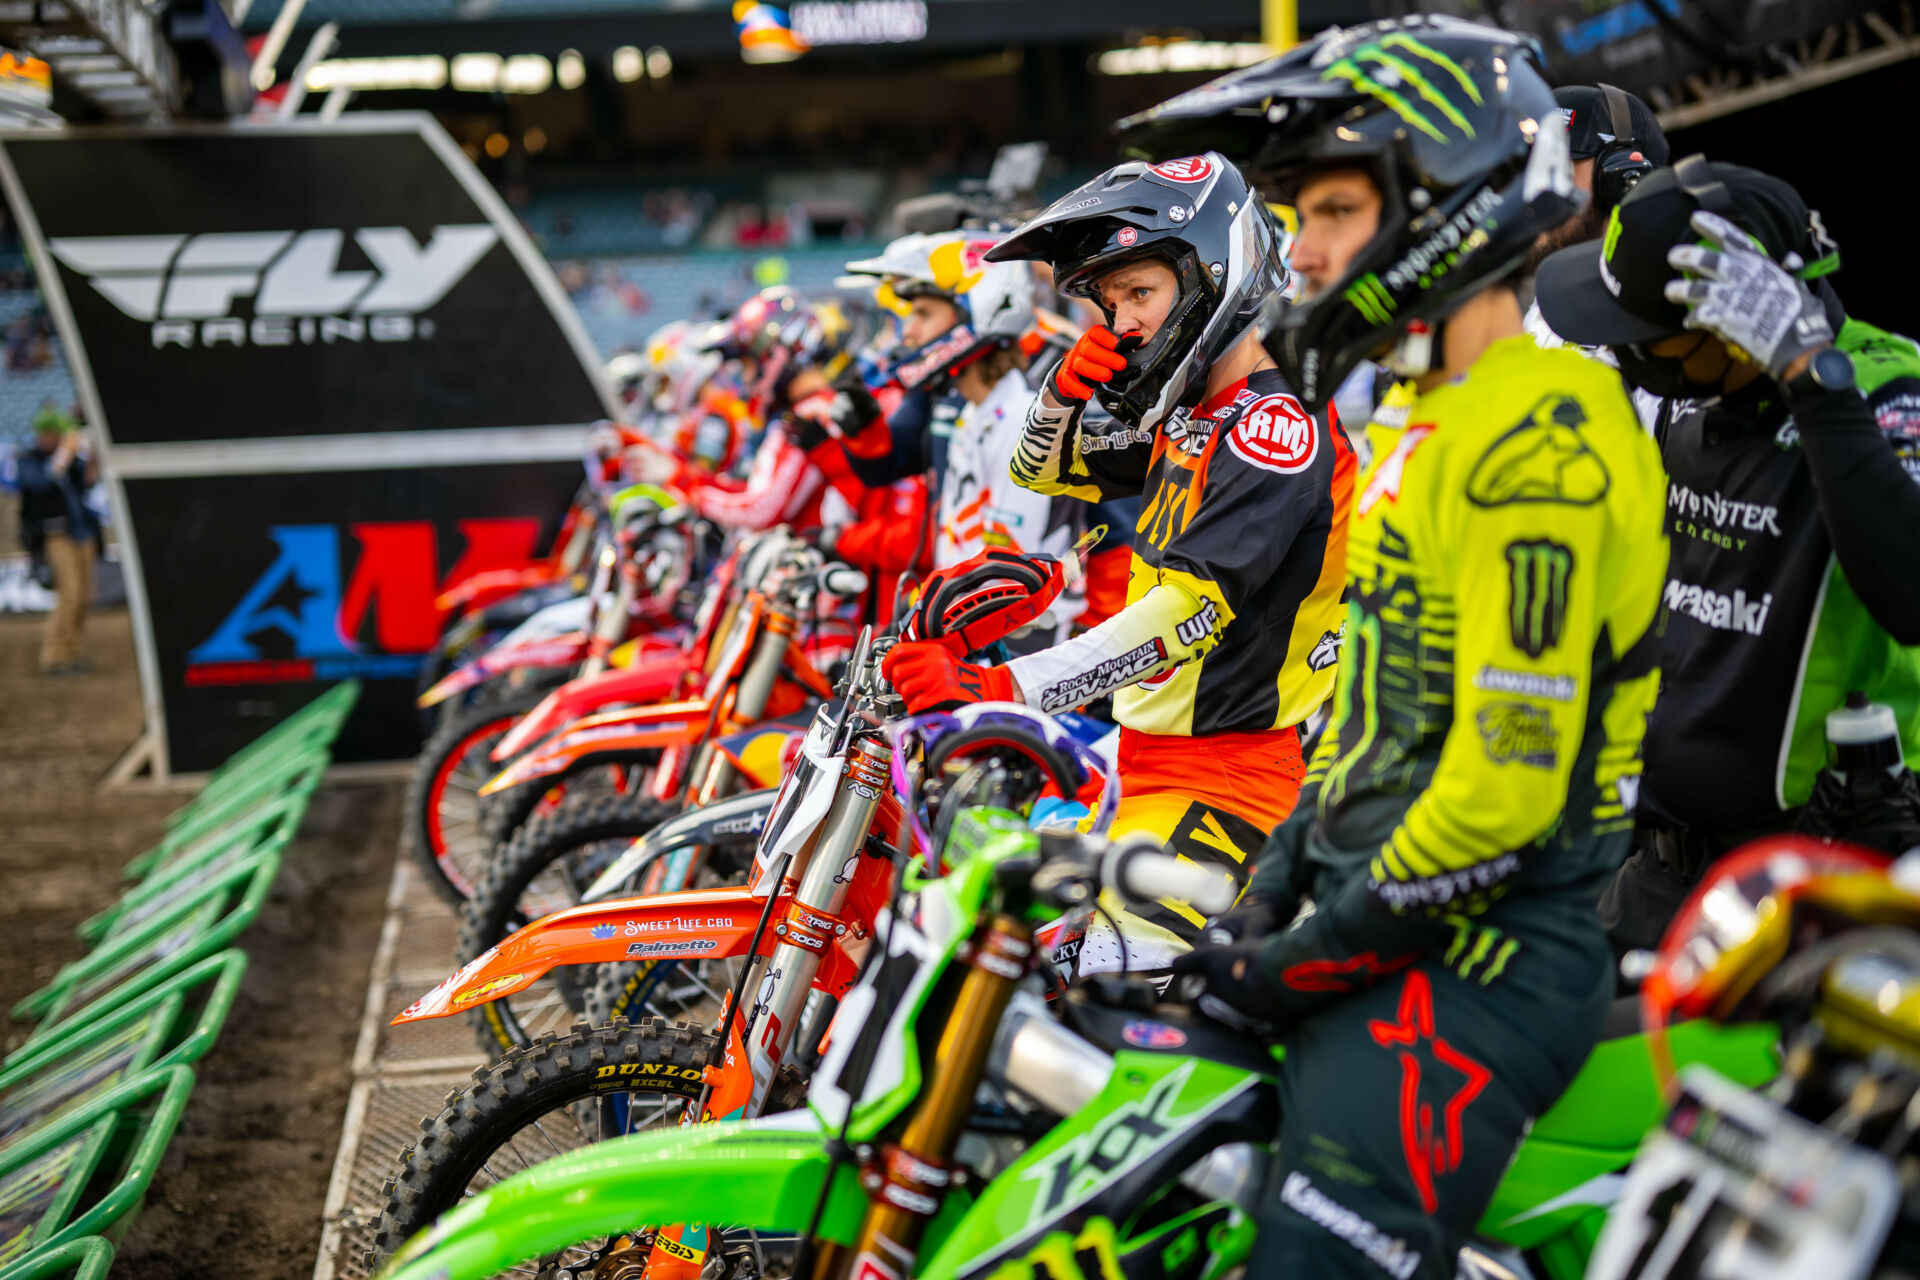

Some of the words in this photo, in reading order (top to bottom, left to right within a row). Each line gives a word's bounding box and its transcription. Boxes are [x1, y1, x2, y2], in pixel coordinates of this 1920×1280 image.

[52, 226, 500, 320] FLY
[151, 316, 416, 349] RACING
[1249, 410, 1305, 452] RM
[1668, 484, 1782, 536] MONSTER
[1675, 520, 1747, 552] ENERGY
[1663, 579, 1773, 636] wasaki
[1059, 671, 1093, 694] ROCKY
[1097, 640, 1156, 677] MOUNTAIN
[862, 755, 889, 771] XTRIG
[857, 771, 885, 786] ROCS
[848, 782, 882, 800] ASV
[624, 920, 671, 936] SWEET
[673, 917, 702, 931] LIFE
[707, 918, 732, 928] CBD
[799, 909, 834, 930] XTRIG
[627, 939, 718, 954] Palmetto
[789, 930, 824, 948] ROCS
[1051, 941, 1081, 964] CKY
[596, 1063, 704, 1083] DUNLO
[630, 1079, 674, 1089] EXCEL
[656, 1235, 695, 1260] ERBIS
